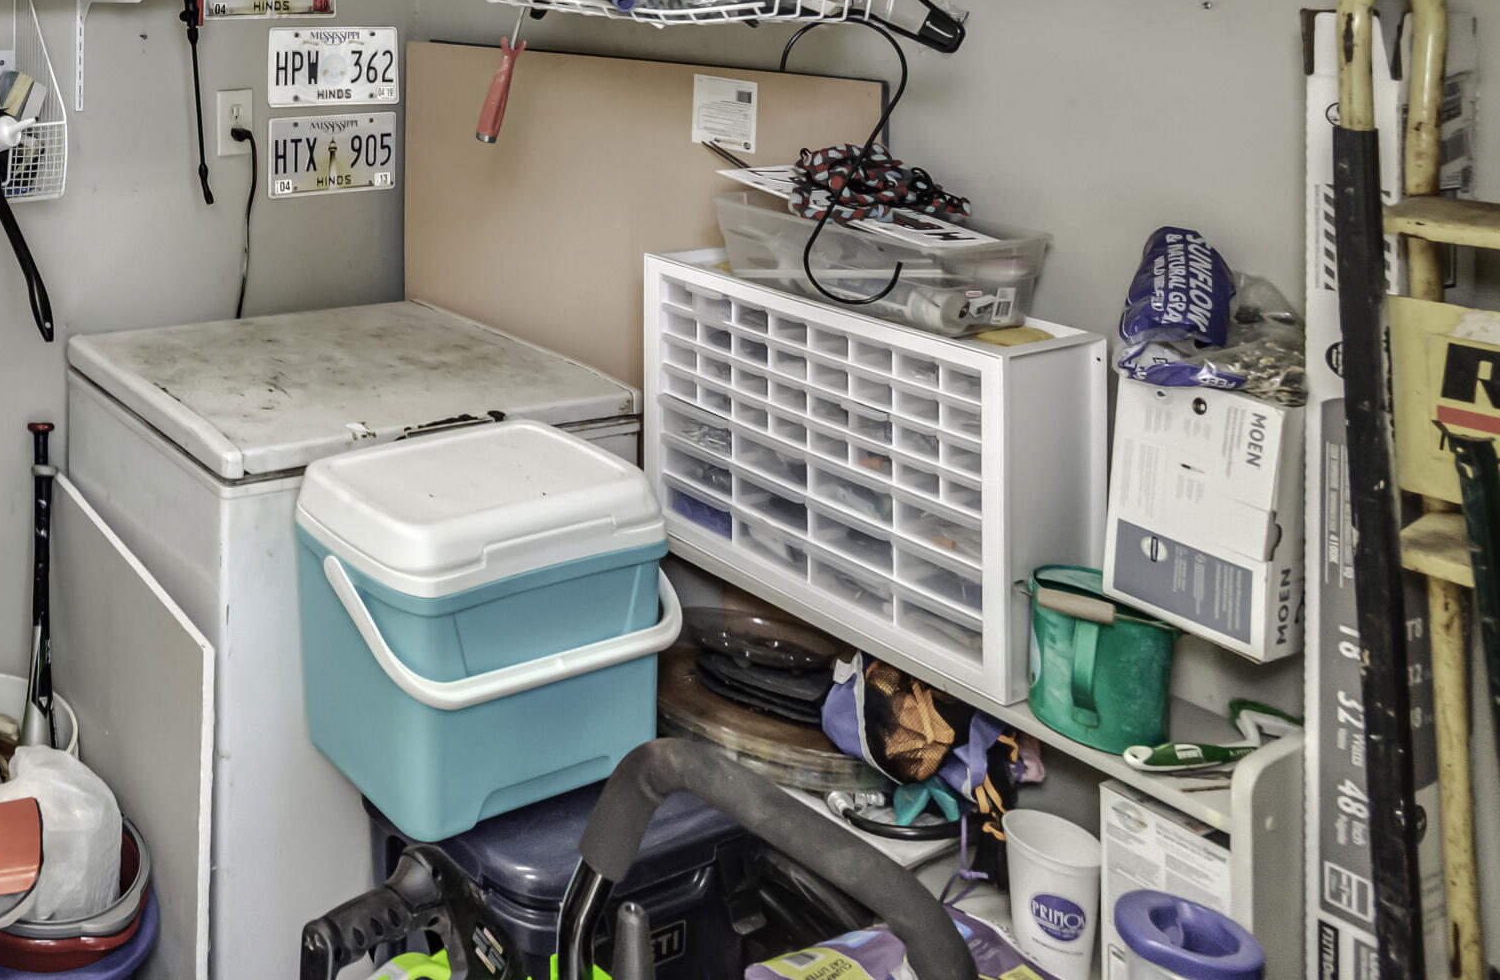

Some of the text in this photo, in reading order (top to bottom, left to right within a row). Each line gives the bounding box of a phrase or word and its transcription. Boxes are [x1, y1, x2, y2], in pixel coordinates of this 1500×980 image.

[215, 3, 226, 15] 04
[254, 1, 290, 12] HINDS
[311, 31, 360, 46] MISSISSIPPI
[275, 50, 395, 86] HPW 362
[317, 89, 352, 99] HINDS
[311, 121, 359, 133] MISSISSIPPI
[274, 133, 392, 174] HTX 905
[280, 180, 291, 192] 04
[317, 175, 352, 187] HINDS
[1167, 243, 1186, 290] NATURAL
[1245, 412, 1267, 467] MOEN
[1276, 568, 1292, 645] MOEN
[1337, 689, 1365, 730] 32
[1337, 778, 1370, 820] 48
